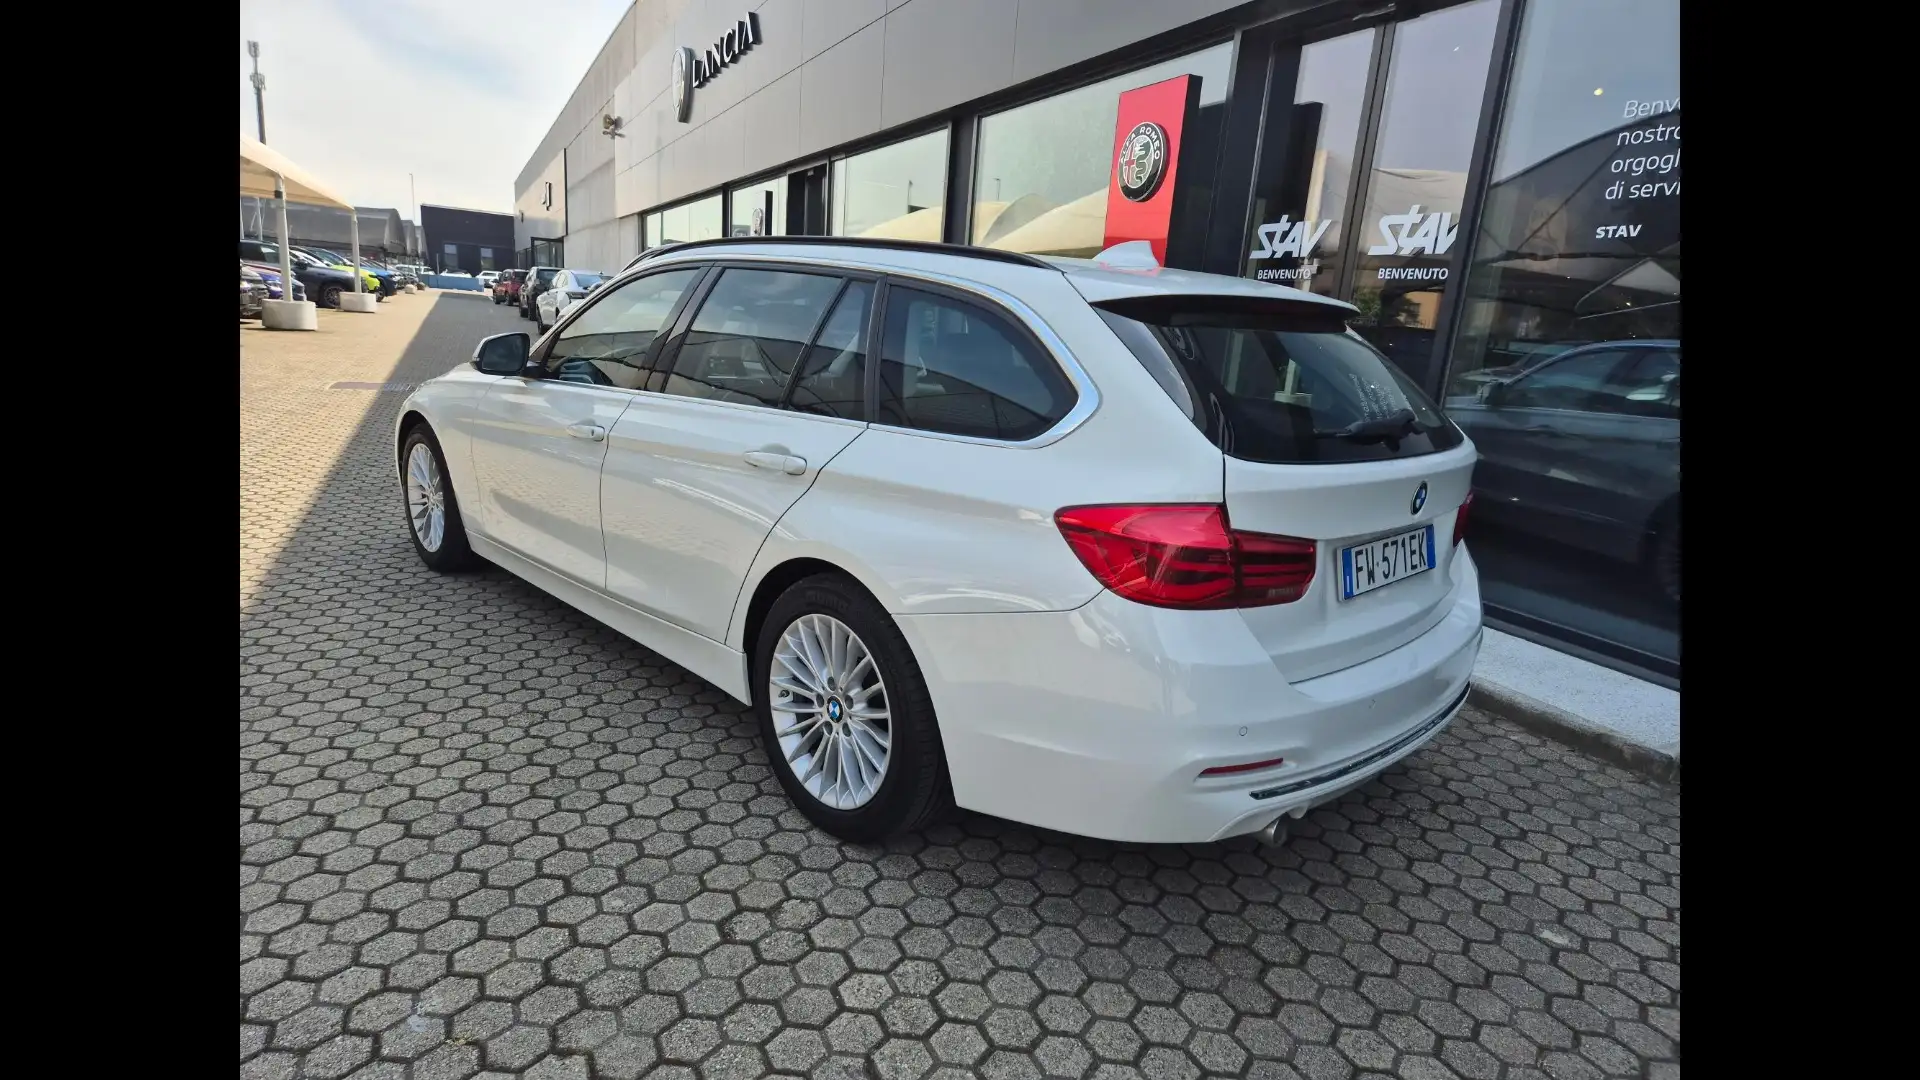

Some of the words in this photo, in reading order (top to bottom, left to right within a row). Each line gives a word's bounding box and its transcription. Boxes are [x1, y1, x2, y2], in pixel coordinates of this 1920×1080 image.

[692, 11, 761, 89] LANCIA
[1139, 126, 1161, 160] ROMEO
[1605, 181, 1625, 200] di
[1595, 224, 1642, 239] STAV
[1257, 269, 1311, 280] BENVENUTO
[1377, 267, 1449, 280] BENVENUTO
